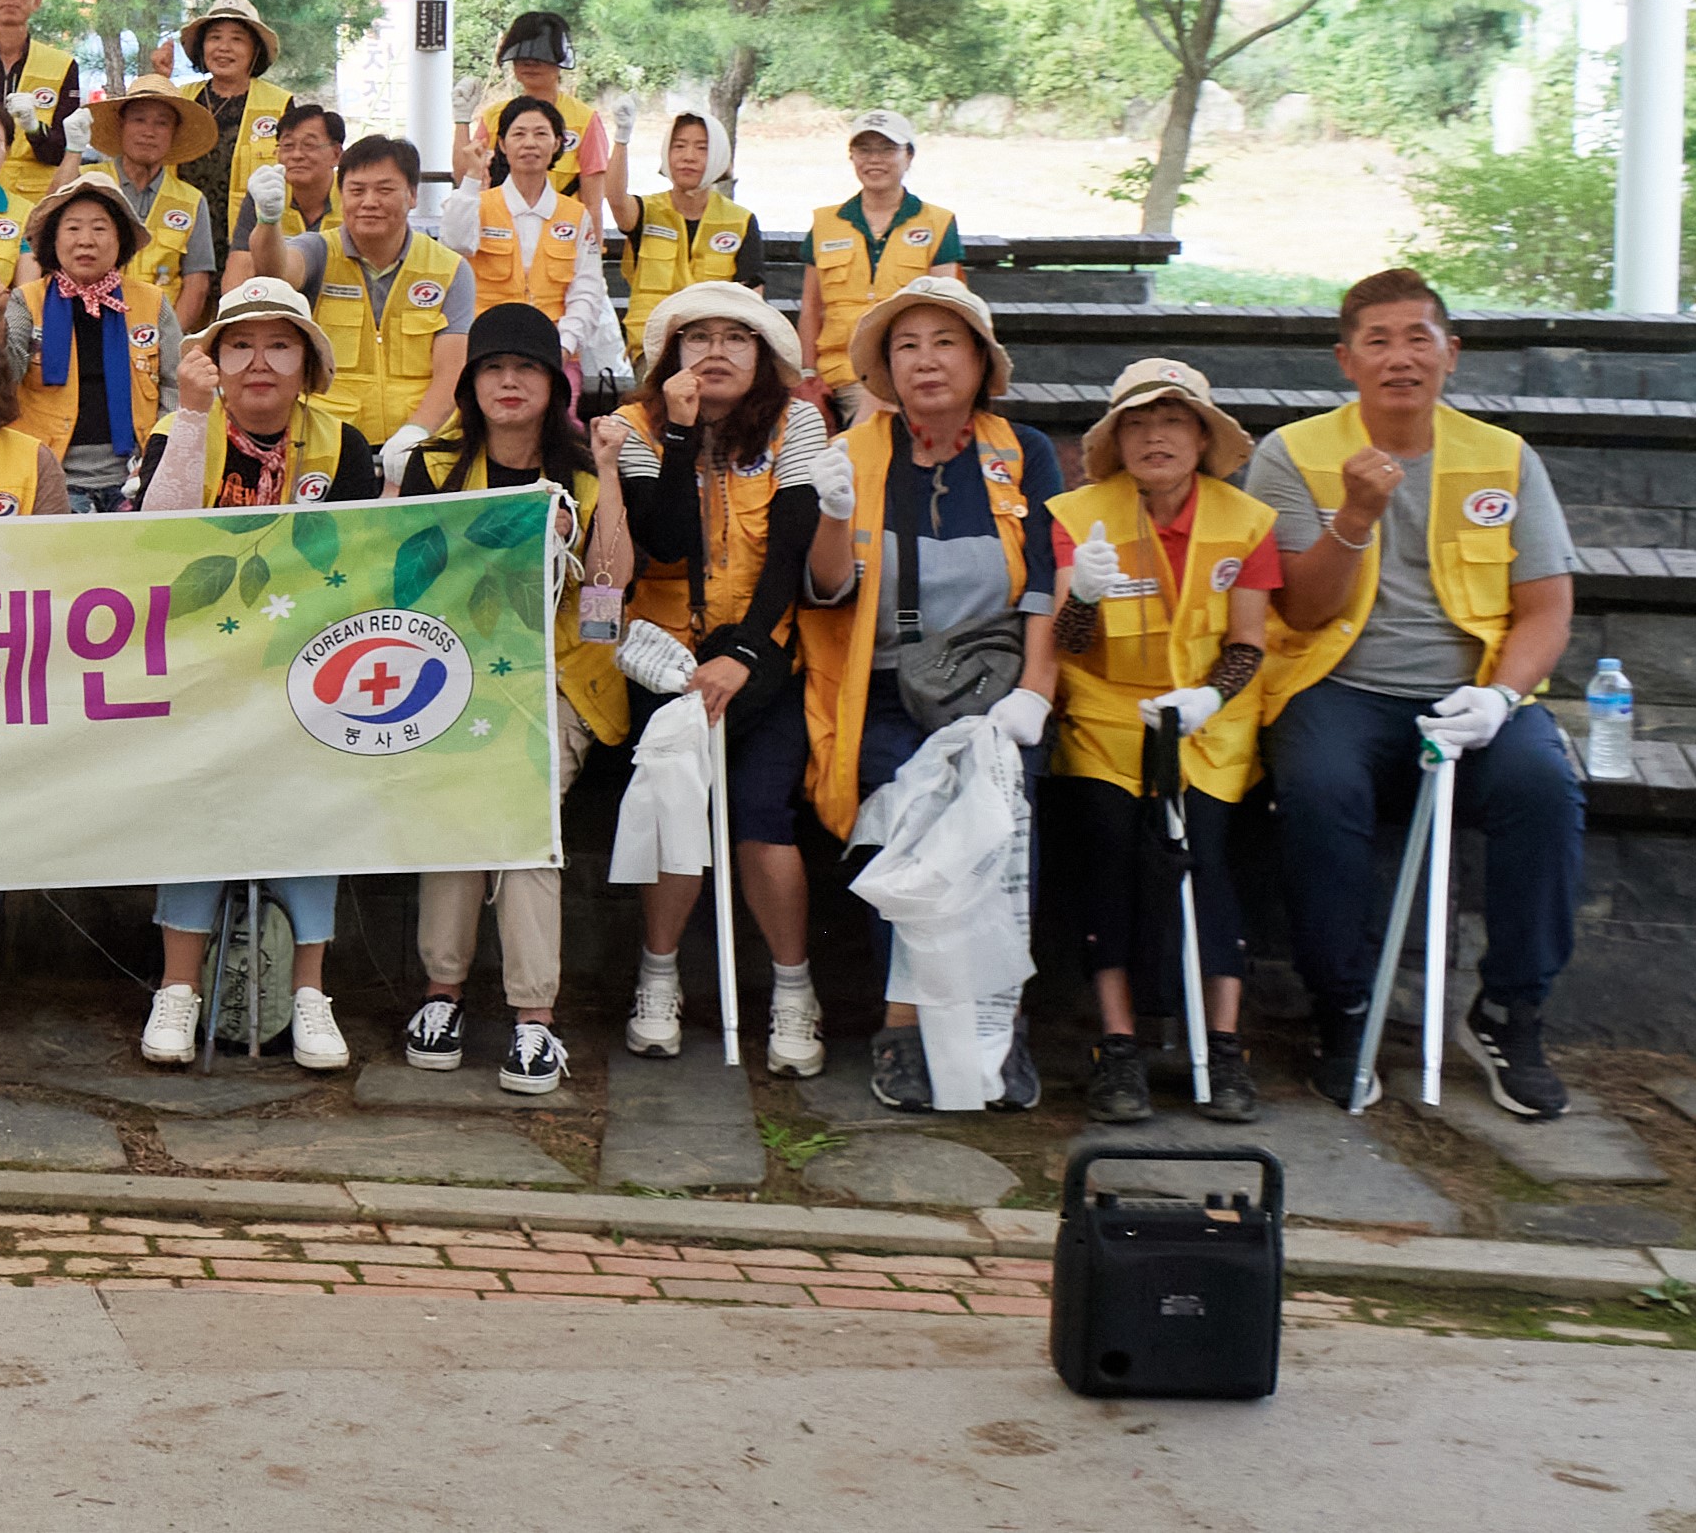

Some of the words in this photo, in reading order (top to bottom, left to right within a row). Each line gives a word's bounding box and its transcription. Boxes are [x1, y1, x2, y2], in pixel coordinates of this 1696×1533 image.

[302, 620, 365, 667] KOREAN
[369, 614, 403, 632] RED
[407, 617, 457, 654] CROSS
[344, 722, 421, 749] 봉사원
